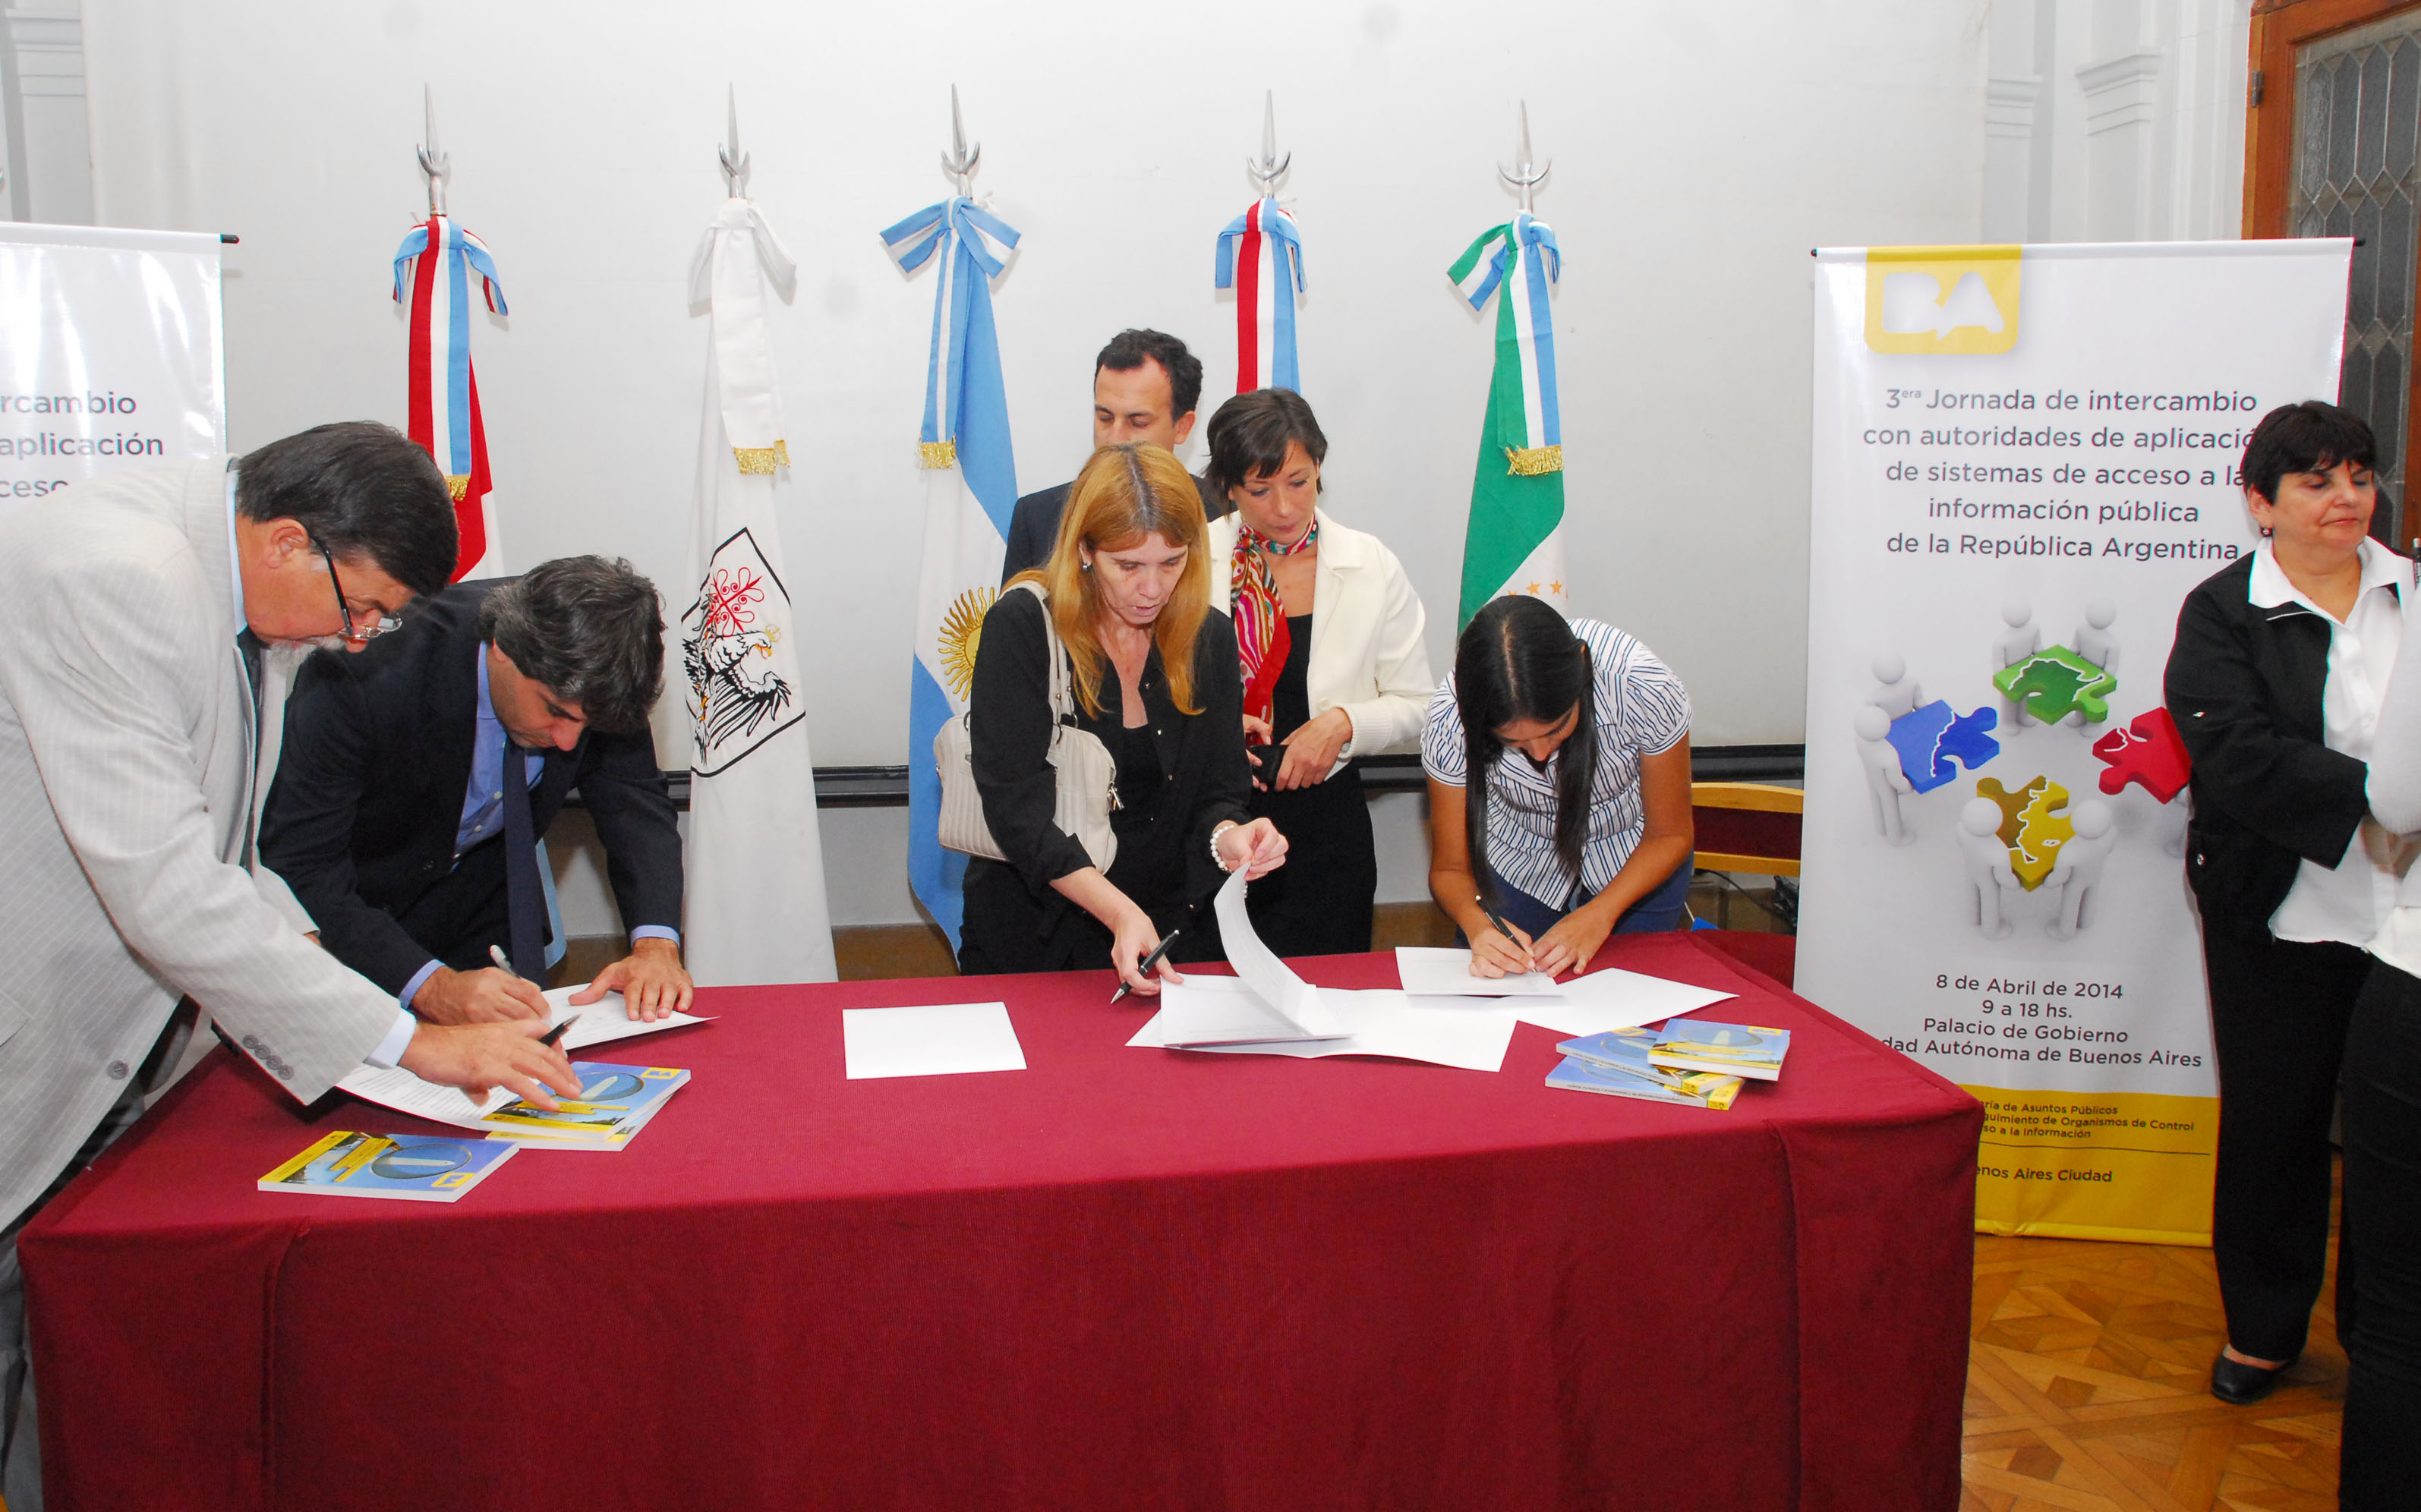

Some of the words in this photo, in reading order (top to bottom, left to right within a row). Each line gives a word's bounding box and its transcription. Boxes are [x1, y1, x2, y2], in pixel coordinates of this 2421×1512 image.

[0, 391, 137, 414] rcambio
[1926, 389, 2035, 409] Jornada
[2045, 389, 2079, 410] de
[2088, 390, 2257, 411] intercambio
[1864, 429, 1911, 445] con
[1920, 426, 2082, 446] autoridades
[2091, 427, 2124, 447] de
[2134, 428, 2256, 452] aplicació
[1886, 461, 1918, 480] de
[1928, 461, 2043, 483] sistemas
[2053, 463, 2085, 484] de
[2095, 468, 2191, 485] acceso
[2200, 470, 2215, 486] a
[1929, 498, 2088, 520] información
[2098, 500, 2199, 524] pública
[1887, 533, 1919, 552] de
[1928, 533, 1950, 553] la
[1960, 534, 2093, 559] República
[2101, 537, 2239, 562] Argentina
[1936, 974, 1947, 988] 8
[1955, 975, 1979, 991] de
[1987, 978, 2035, 995] Abril
[2043, 981, 2067, 996] de
[2074, 982, 2123, 999] 2014
[1982, 1000, 1994, 1014] 9
[2001, 1004, 2012, 1016] a
[2019, 1003, 2039, 1017] 18
[2046, 1003, 2072, 1018] hs.
[1924, 1018, 1995, 1035] Palacio
[2003, 1024, 2027, 1039] de
[2035, 1025, 2128, 1043] Gobierno
[1883, 1036, 1918, 1053] dad
[1925, 1040, 2030, 1061] Autónoma
[2037, 1047, 2061, 1061] de
[2069, 1048, 2142, 1064] Buenos
[2148, 1050, 2202, 1067] Aires
[2003, 1103, 2017, 1111] de
[2021, 1104, 2066, 1113] Asuntos
[2070, 1105, 2118, 1115] Públicos
[2010, 1126, 2019, 1136] la
[2023, 1127, 2091, 1138] Información
[2042, 1116, 2057, 1125] de
[2060, 1117, 2128, 1128] Organismos
[2131, 1118, 2147, 1128] de
[2150, 1120, 2195, 1130] Control
[2013, 1168, 2053, 1180] Aires
[2057, 1169, 2113, 1182] Ciudad
